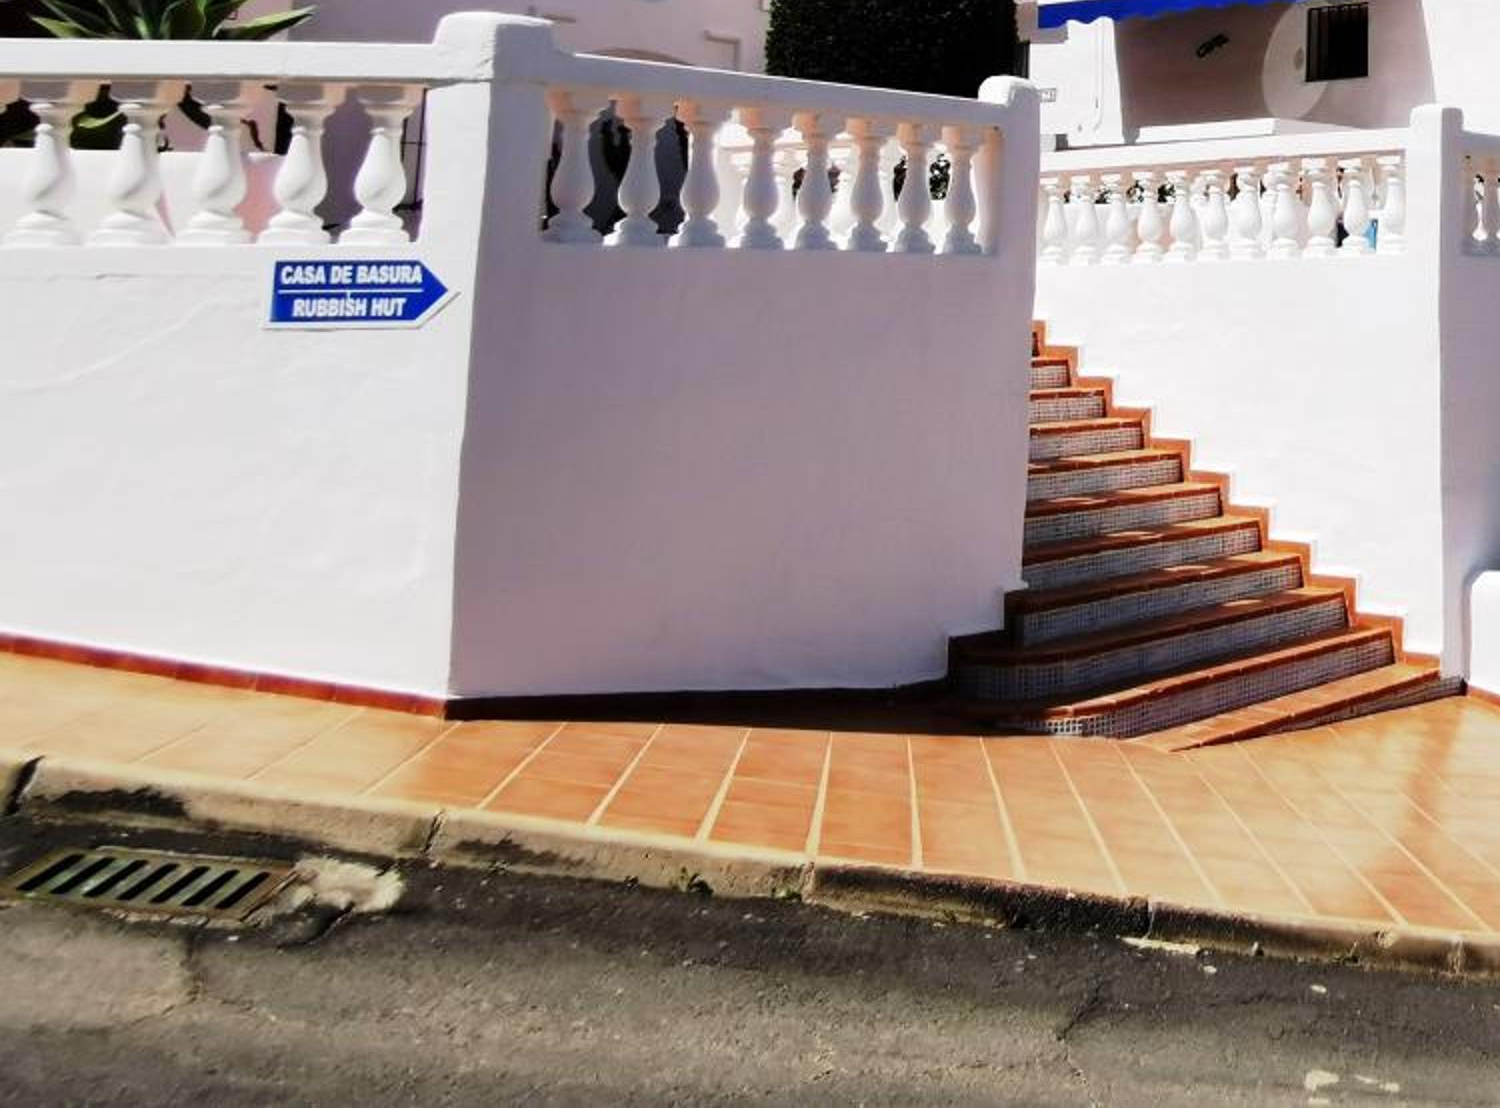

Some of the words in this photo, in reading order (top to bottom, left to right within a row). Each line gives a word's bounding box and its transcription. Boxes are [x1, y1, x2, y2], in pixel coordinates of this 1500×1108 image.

[281, 266, 325, 284] CASA
[330, 266, 353, 284] DE
[356, 266, 423, 284] BASURA
[292, 298, 368, 317] RUBBISH
[371, 298, 406, 317] HUT
